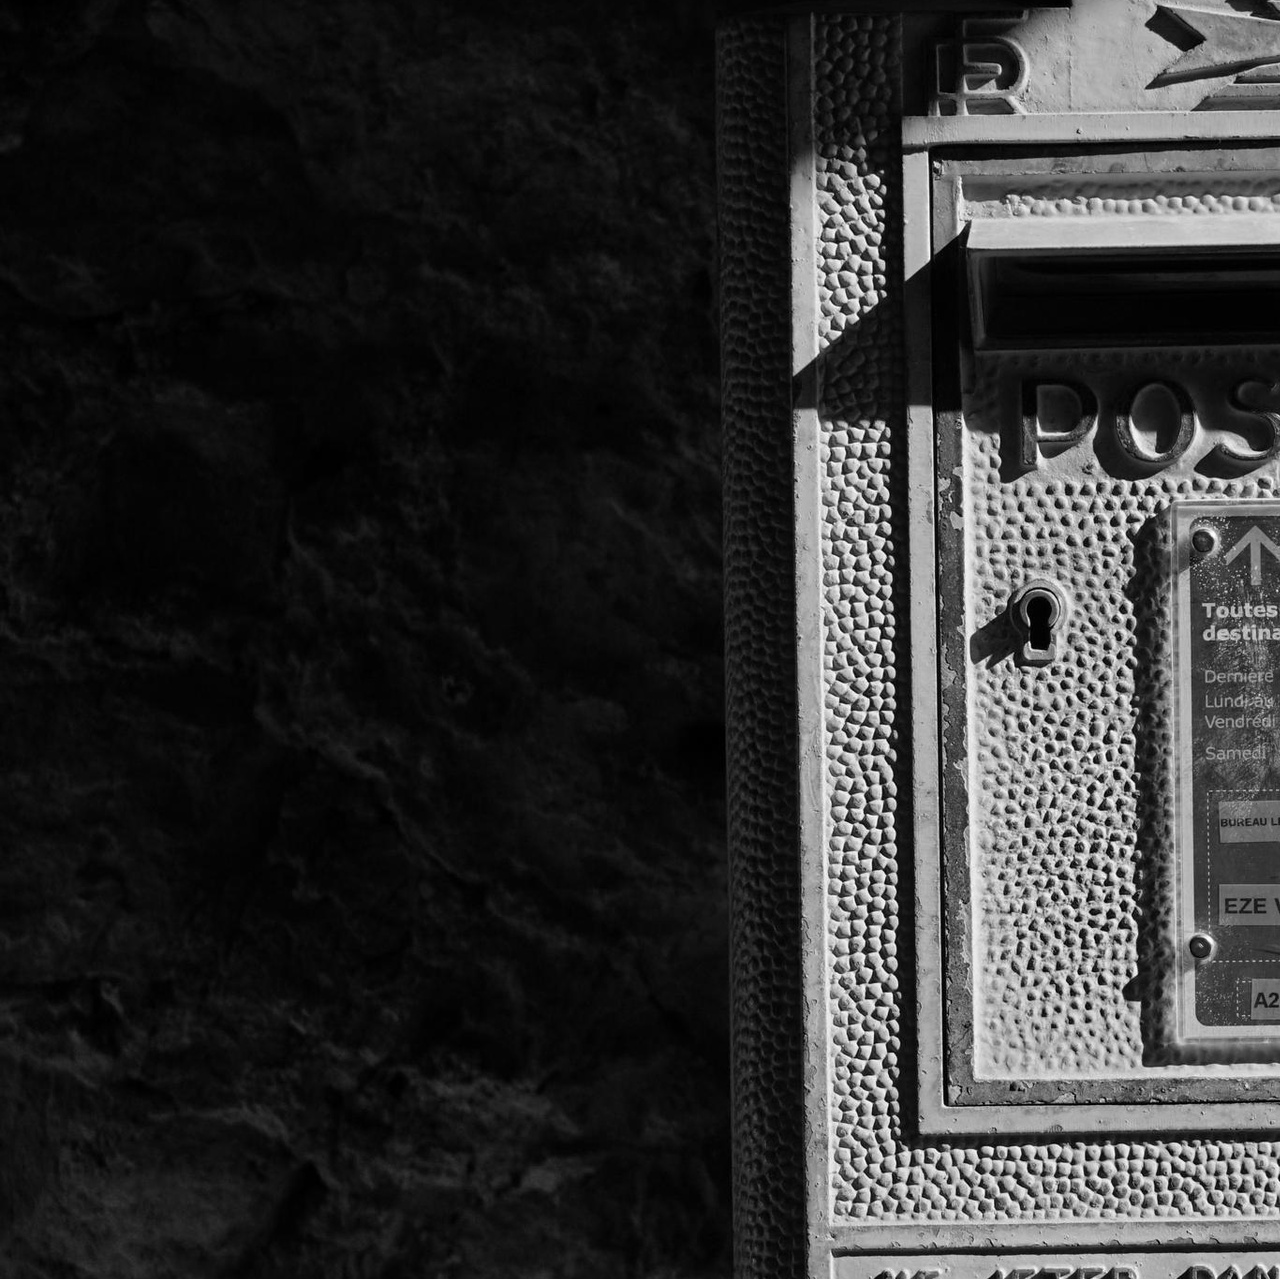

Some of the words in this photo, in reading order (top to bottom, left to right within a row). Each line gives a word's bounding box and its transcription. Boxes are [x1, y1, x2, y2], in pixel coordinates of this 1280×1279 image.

[1202, 602, 1278, 618] Toutes
[1204, 694, 1247, 708] Lundi
[1204, 714, 1276, 728] Vendredi
[1205, 744, 1267, 760] Samedi
[1220, 817, 1267, 828] BUREAU
[1224, 898, 1267, 914] EZE
